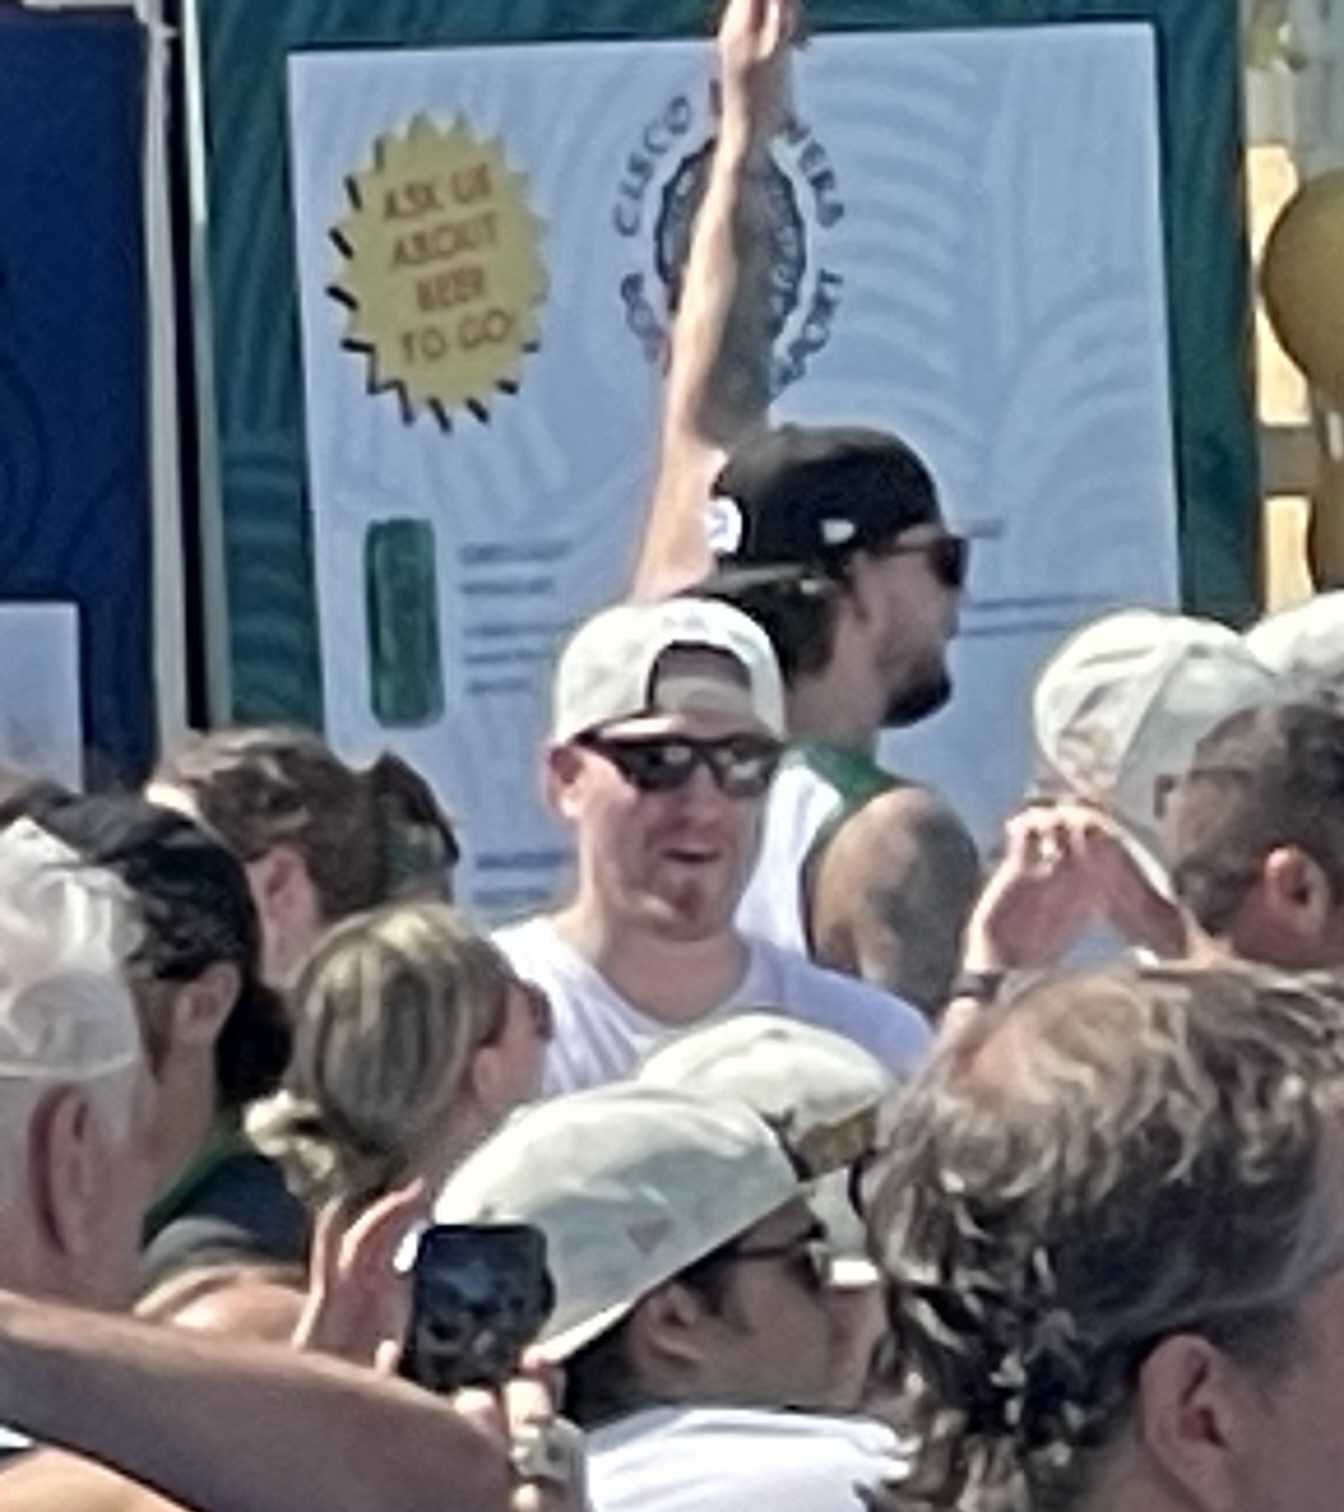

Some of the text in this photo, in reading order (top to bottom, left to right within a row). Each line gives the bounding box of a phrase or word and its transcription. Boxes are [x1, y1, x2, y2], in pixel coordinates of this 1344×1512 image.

[611, 95, 692, 238] CISCO
[383, 180, 443, 221] ASK
[387, 210, 498, 270] ABOUT
[402, 307, 518, 365] TO GO
